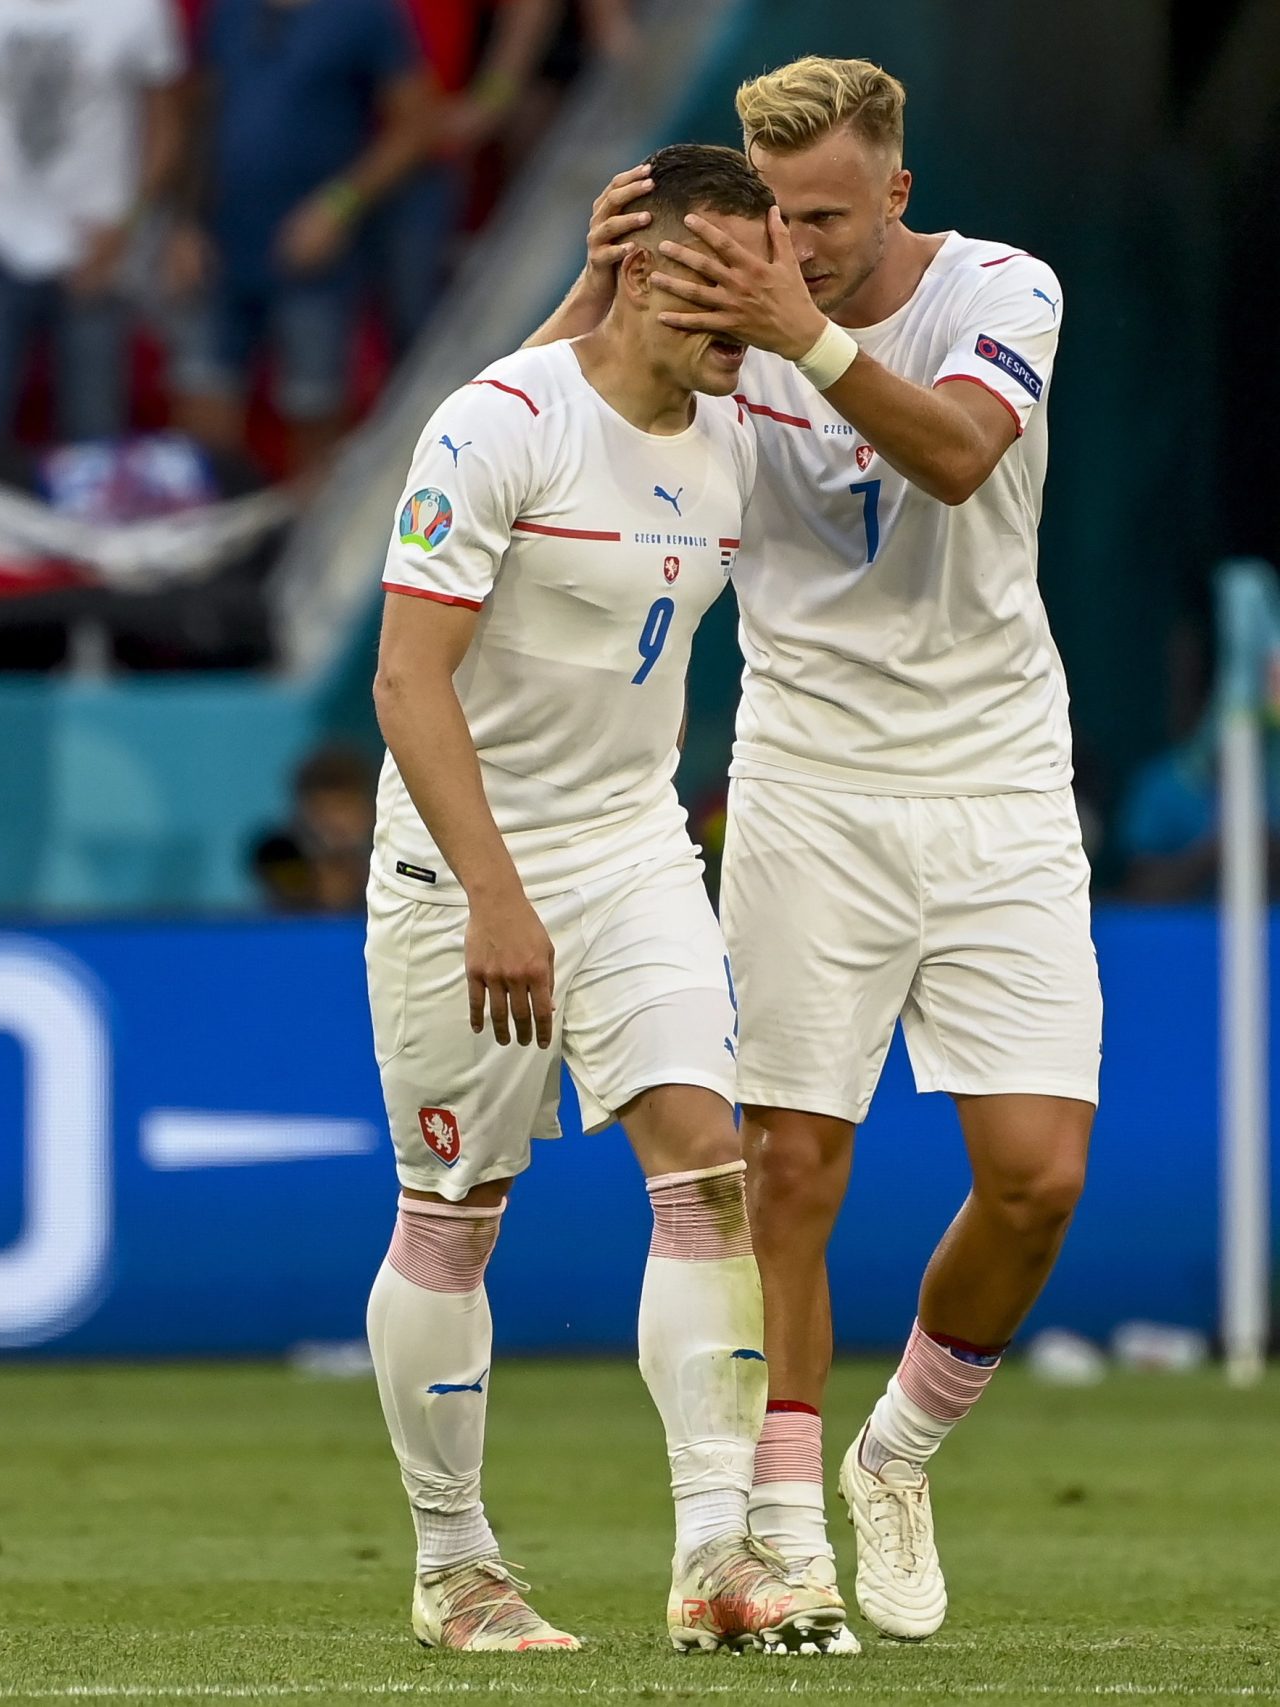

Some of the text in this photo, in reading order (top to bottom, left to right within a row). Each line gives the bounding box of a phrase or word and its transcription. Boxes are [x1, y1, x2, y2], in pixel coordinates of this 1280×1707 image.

[998, 351, 1041, 395] RESPECT
[634, 533, 707, 547] CZECH REPUBLIC
[849, 479, 881, 564] 7
[630, 596, 675, 685] 9
